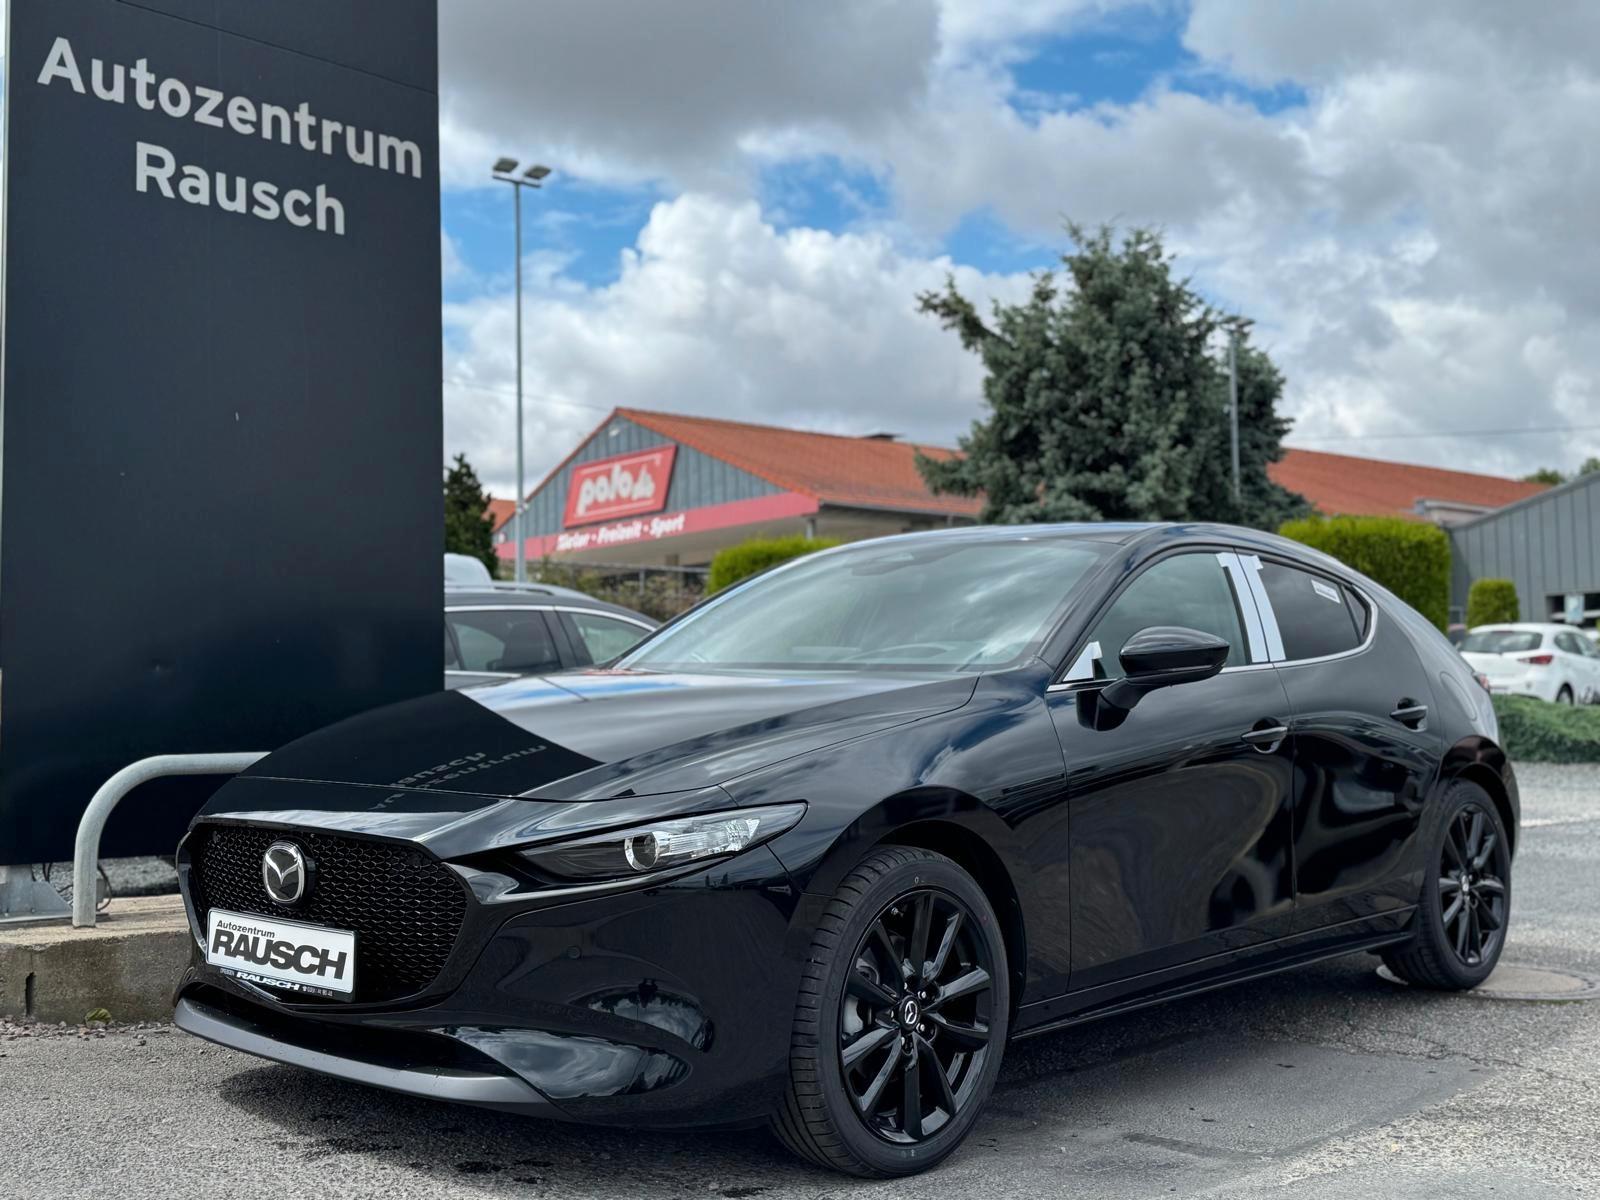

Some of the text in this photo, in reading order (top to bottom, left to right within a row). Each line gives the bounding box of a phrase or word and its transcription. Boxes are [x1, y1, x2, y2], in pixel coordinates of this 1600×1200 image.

[37, 36, 422, 179] Autozentrum
[135, 141, 345, 236] Rausch
[597, 520, 642, 544] Freizeit
[649, 513, 685, 539] Sport
[216, 919, 276, 939] Autozentrum
[211, 928, 348, 981] RAUSCH
[236, 971, 300, 991] RAUSCH
